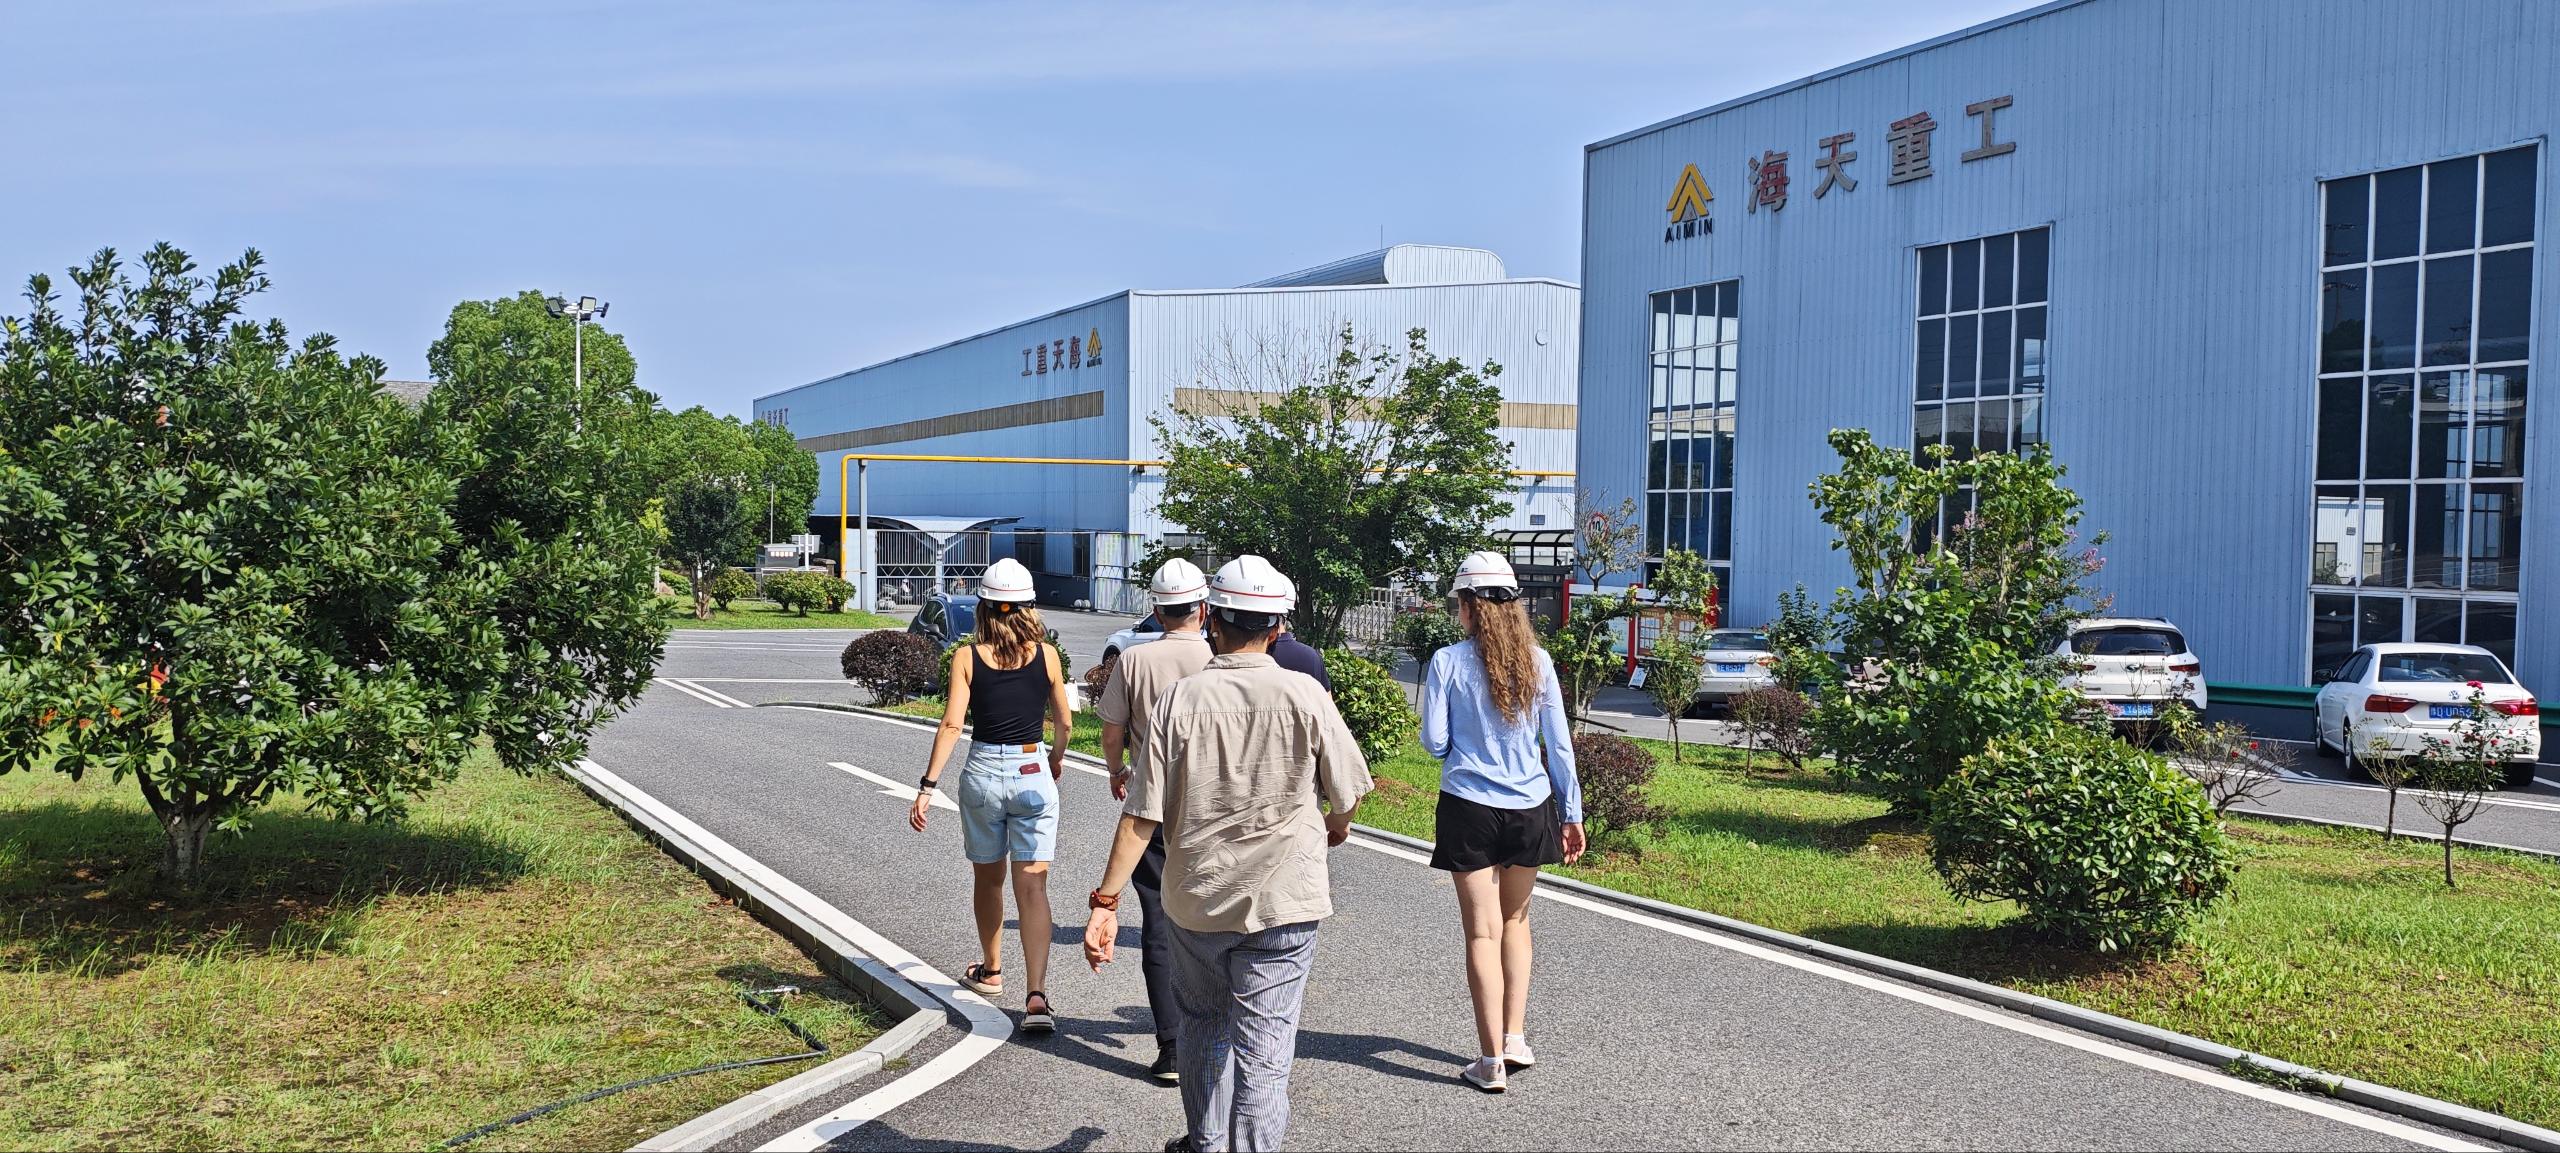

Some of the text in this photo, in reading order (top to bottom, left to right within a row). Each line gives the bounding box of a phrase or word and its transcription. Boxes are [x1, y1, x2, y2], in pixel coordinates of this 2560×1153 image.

[1748, 95, 2017, 213] 海天重工
[1664, 217, 1713, 243] AIMIN
